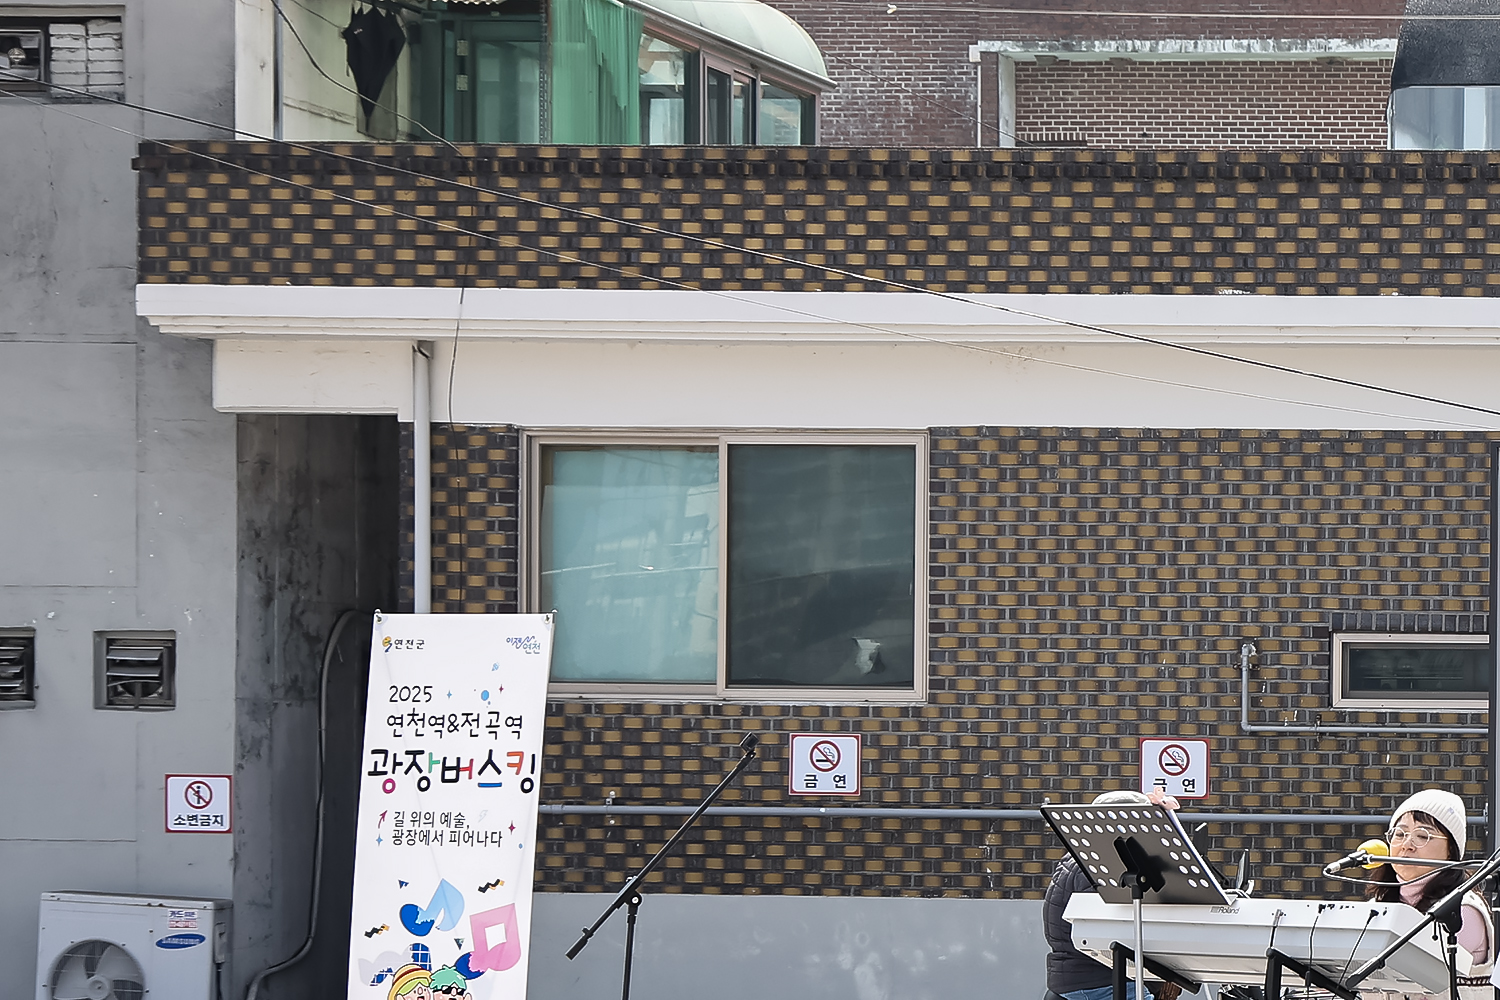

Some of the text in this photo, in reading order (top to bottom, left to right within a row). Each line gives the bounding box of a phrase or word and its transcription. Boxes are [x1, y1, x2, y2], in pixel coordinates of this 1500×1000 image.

[389, 685, 433, 703] 2025
[386, 707, 523, 740] 연천역&전곡역
[367, 749, 535, 794] 광장버스킹
[173, 813, 224, 827] 소변금지
[393, 810, 470, 829] 길 위의 예술,
[392, 829, 503, 848] 광장에서 피어나다
[1219, 906, 1240, 914] Roland
